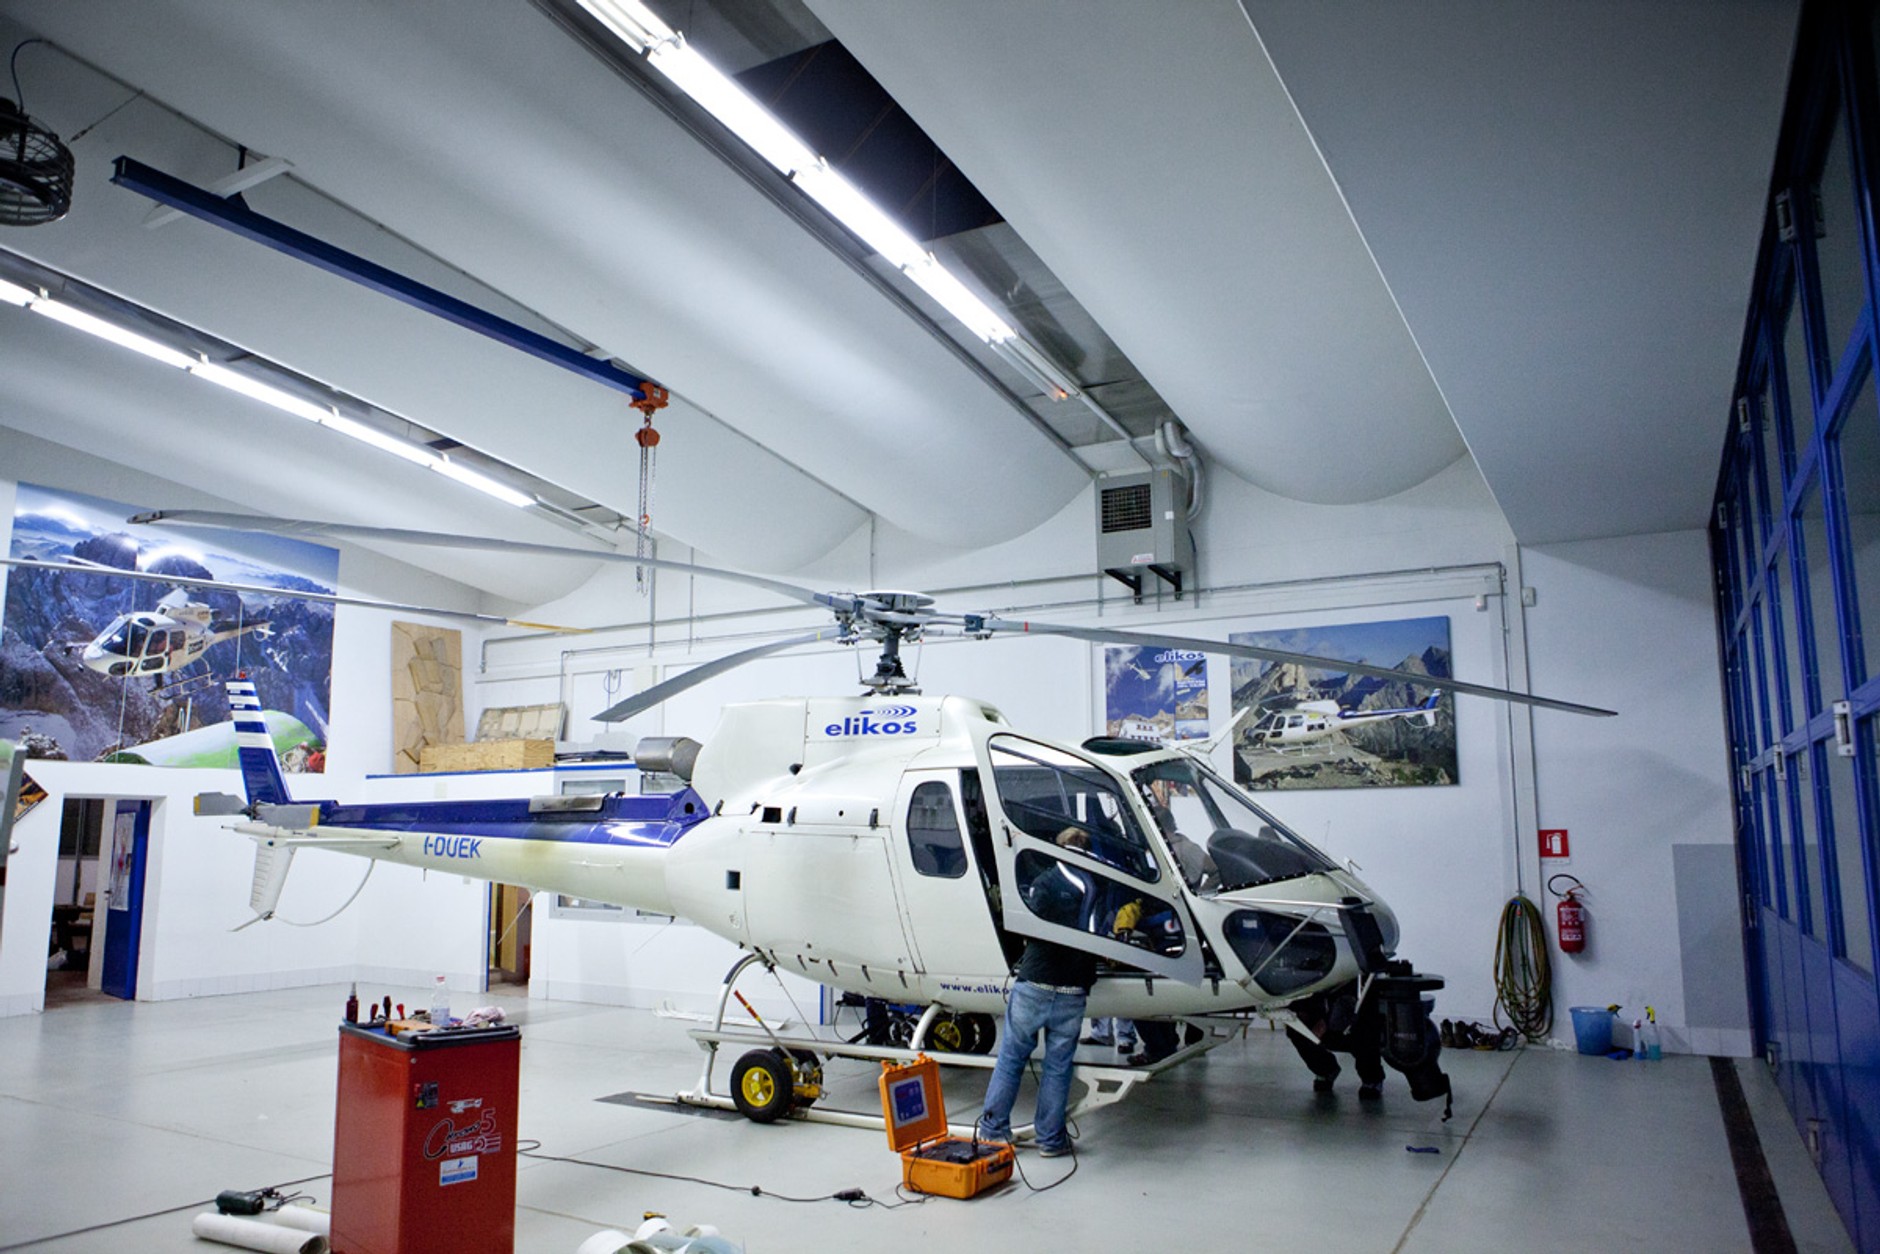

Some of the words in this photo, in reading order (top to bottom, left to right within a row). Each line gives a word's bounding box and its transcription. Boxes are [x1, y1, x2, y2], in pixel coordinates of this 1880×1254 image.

[1154, 649, 1205, 662] elikos
[825, 716, 918, 737] elikos
[424, 836, 482, 858] I-DUEK
[940, 982, 1012, 994] www.eliko
